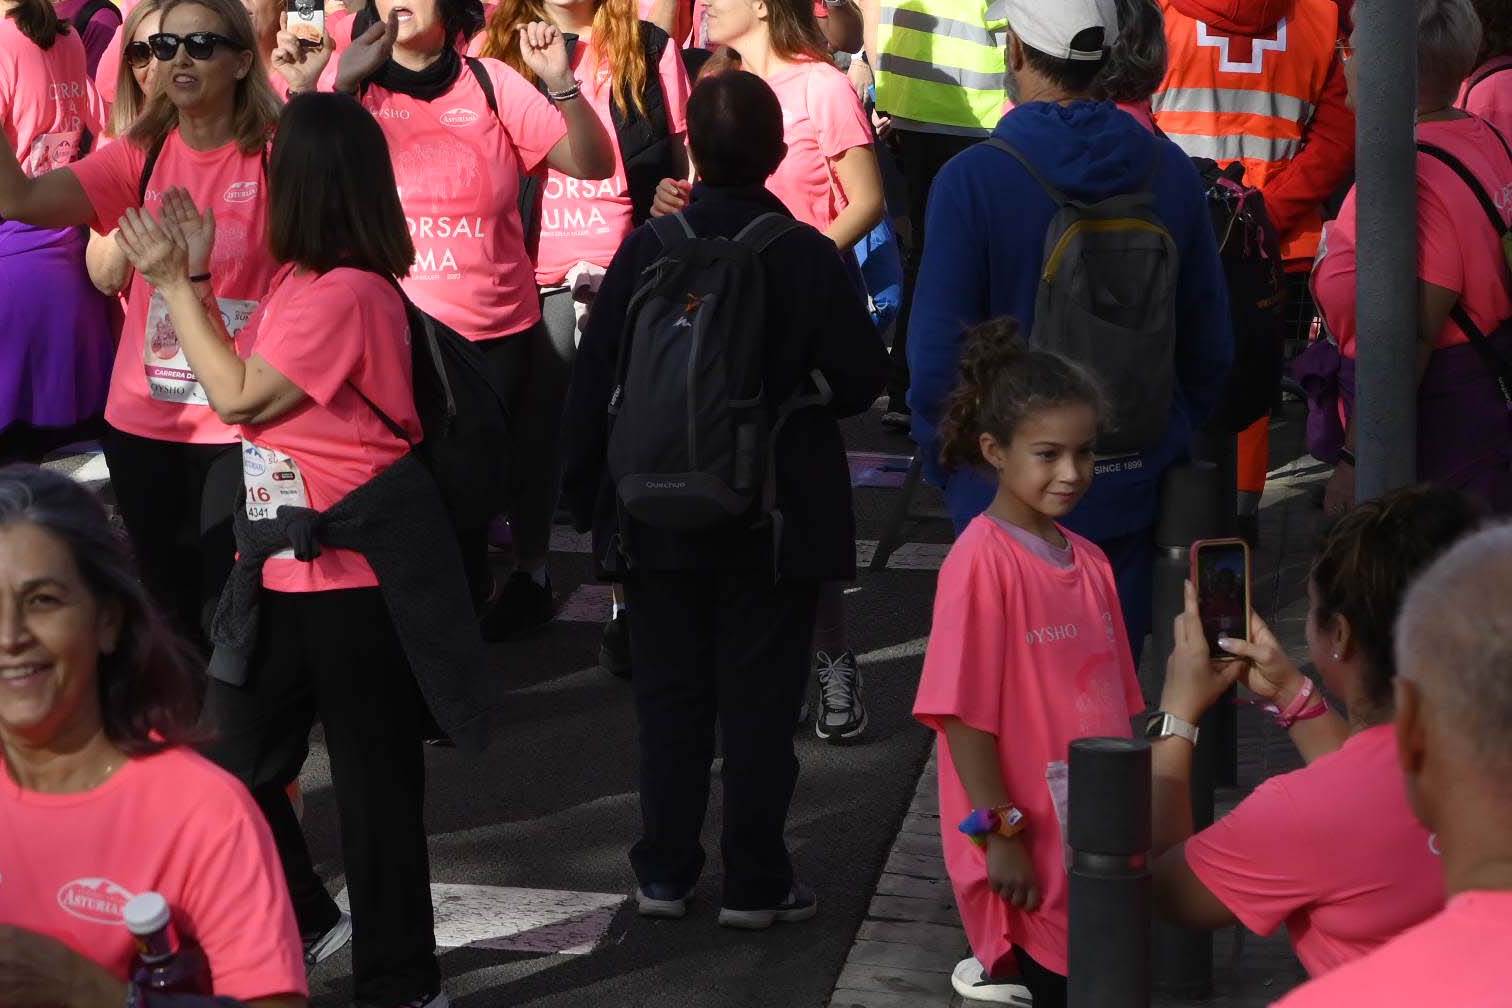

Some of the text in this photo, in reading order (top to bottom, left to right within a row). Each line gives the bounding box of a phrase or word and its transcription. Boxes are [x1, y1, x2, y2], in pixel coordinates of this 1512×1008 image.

[543, 208, 607, 228] UMA
[413, 248, 458, 271] MA
[155, 369, 185, 379] CARRERA
[151, 383, 185, 394] OYSHO
[1094, 463, 1121, 474] SINCE
[248, 487, 271, 502] 16
[1026, 623, 1077, 645] OYSHO
[64, 889, 124, 914] ASTURIA
